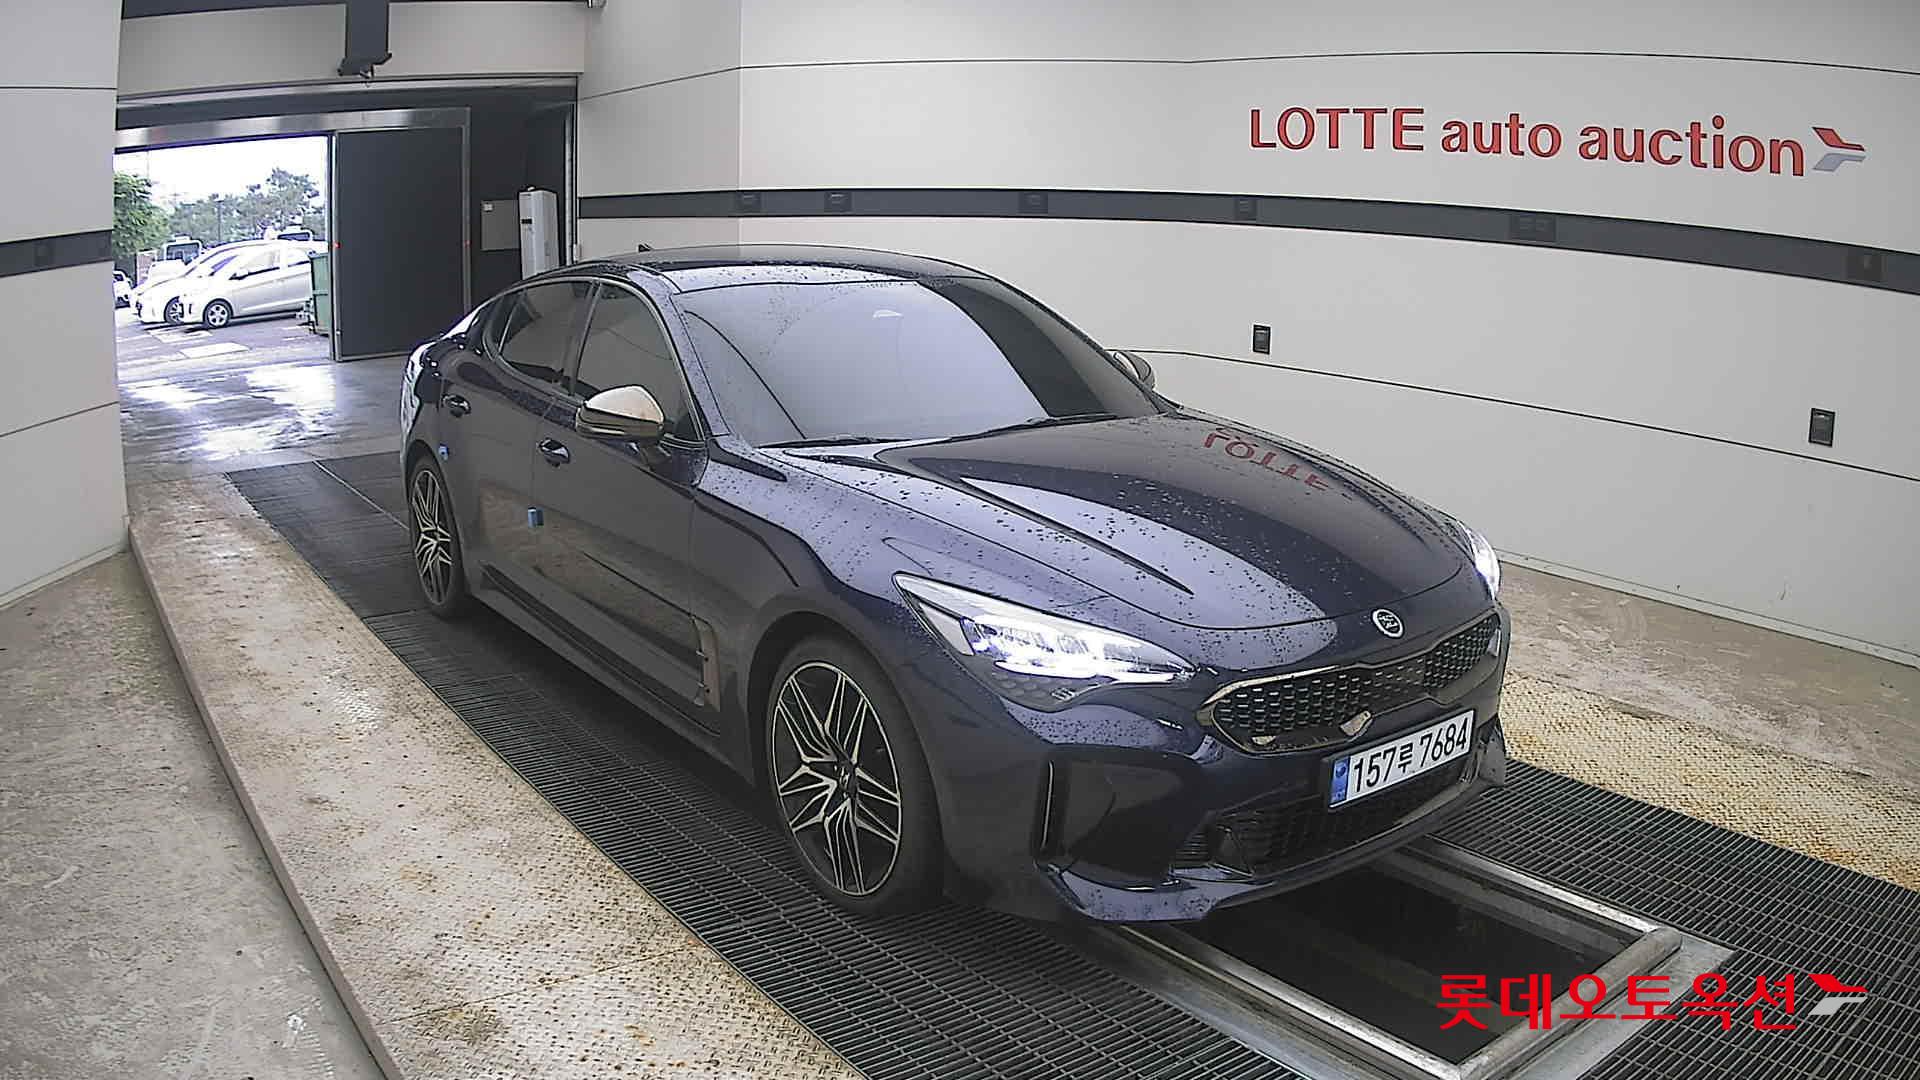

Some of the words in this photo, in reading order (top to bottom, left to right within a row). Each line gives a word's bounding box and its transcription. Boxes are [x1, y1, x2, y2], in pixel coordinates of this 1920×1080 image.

[1250, 107, 1424, 151] LOTTE
[1441, 113, 1563, 158] auto
[1577, 115, 1805, 177] auction
[1353, 742, 1414, 792] 157루
[1419, 717, 1468, 768] 7684
